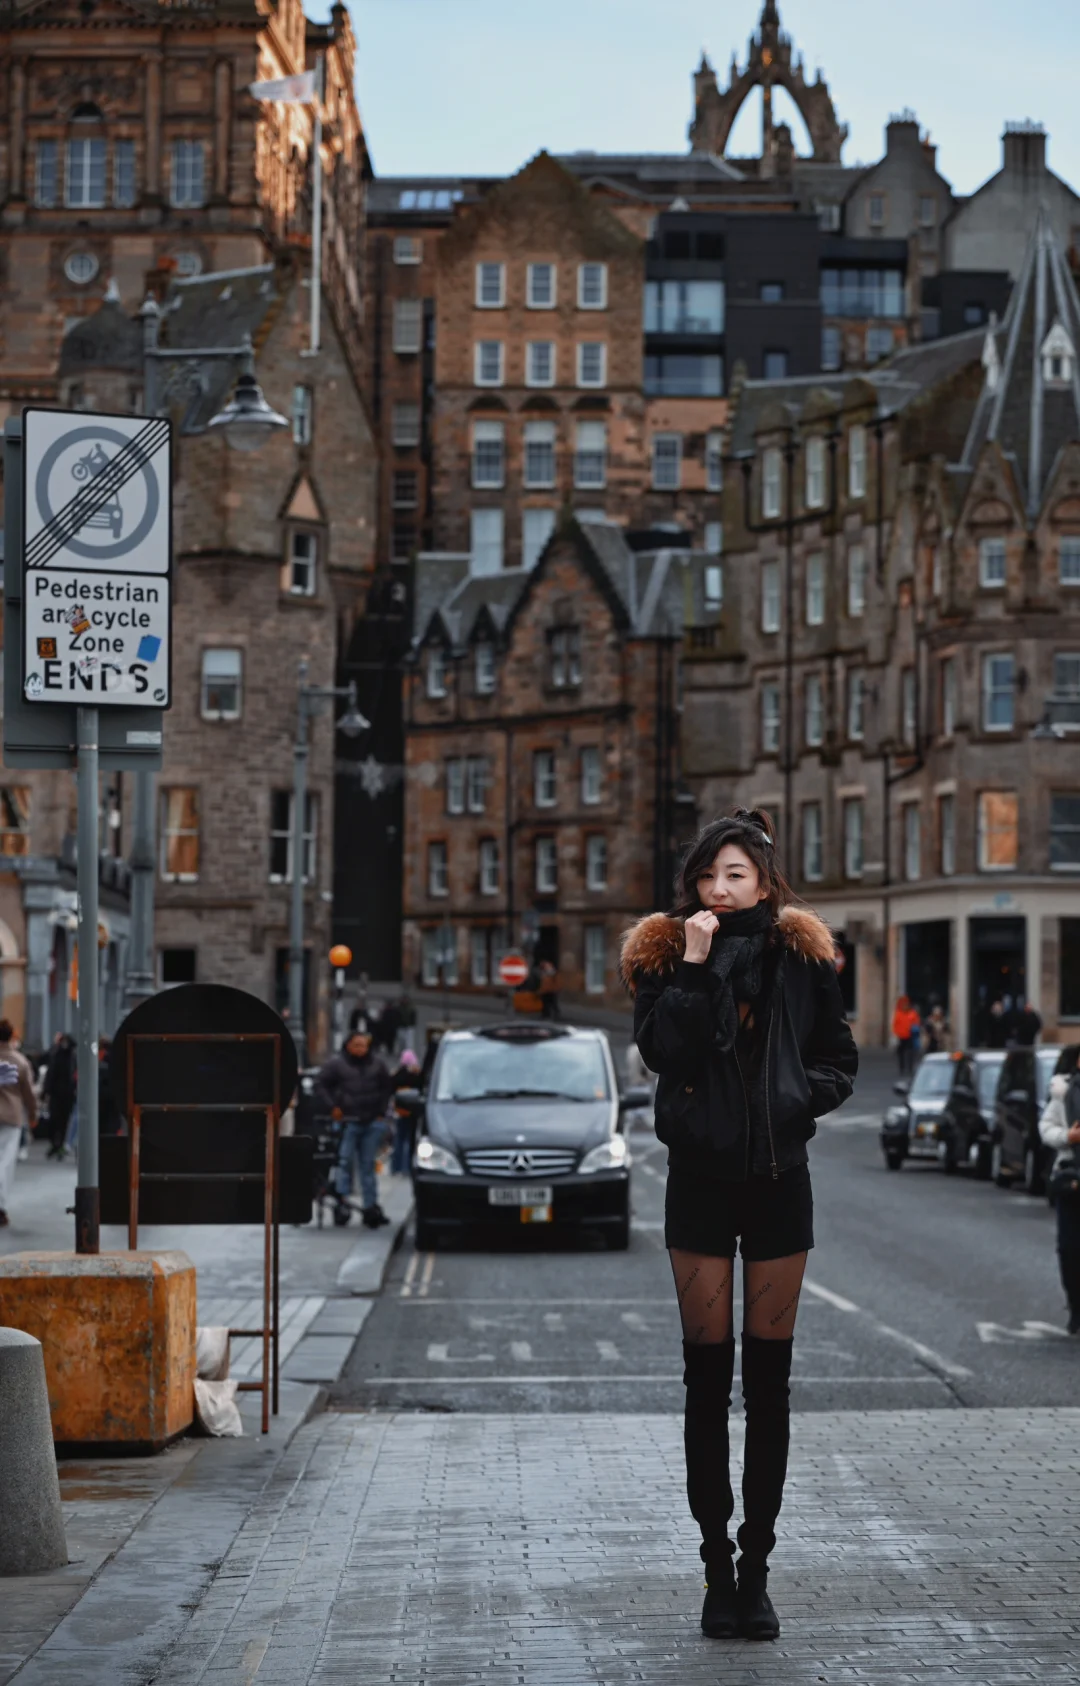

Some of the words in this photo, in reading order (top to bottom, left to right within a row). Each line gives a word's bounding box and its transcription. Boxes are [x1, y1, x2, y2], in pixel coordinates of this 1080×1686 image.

[35, 577, 159, 603] Pedestrian
[42, 605, 84, 624] an
[91, 608, 151, 630] cycle
[69, 631, 124, 652] Zone
